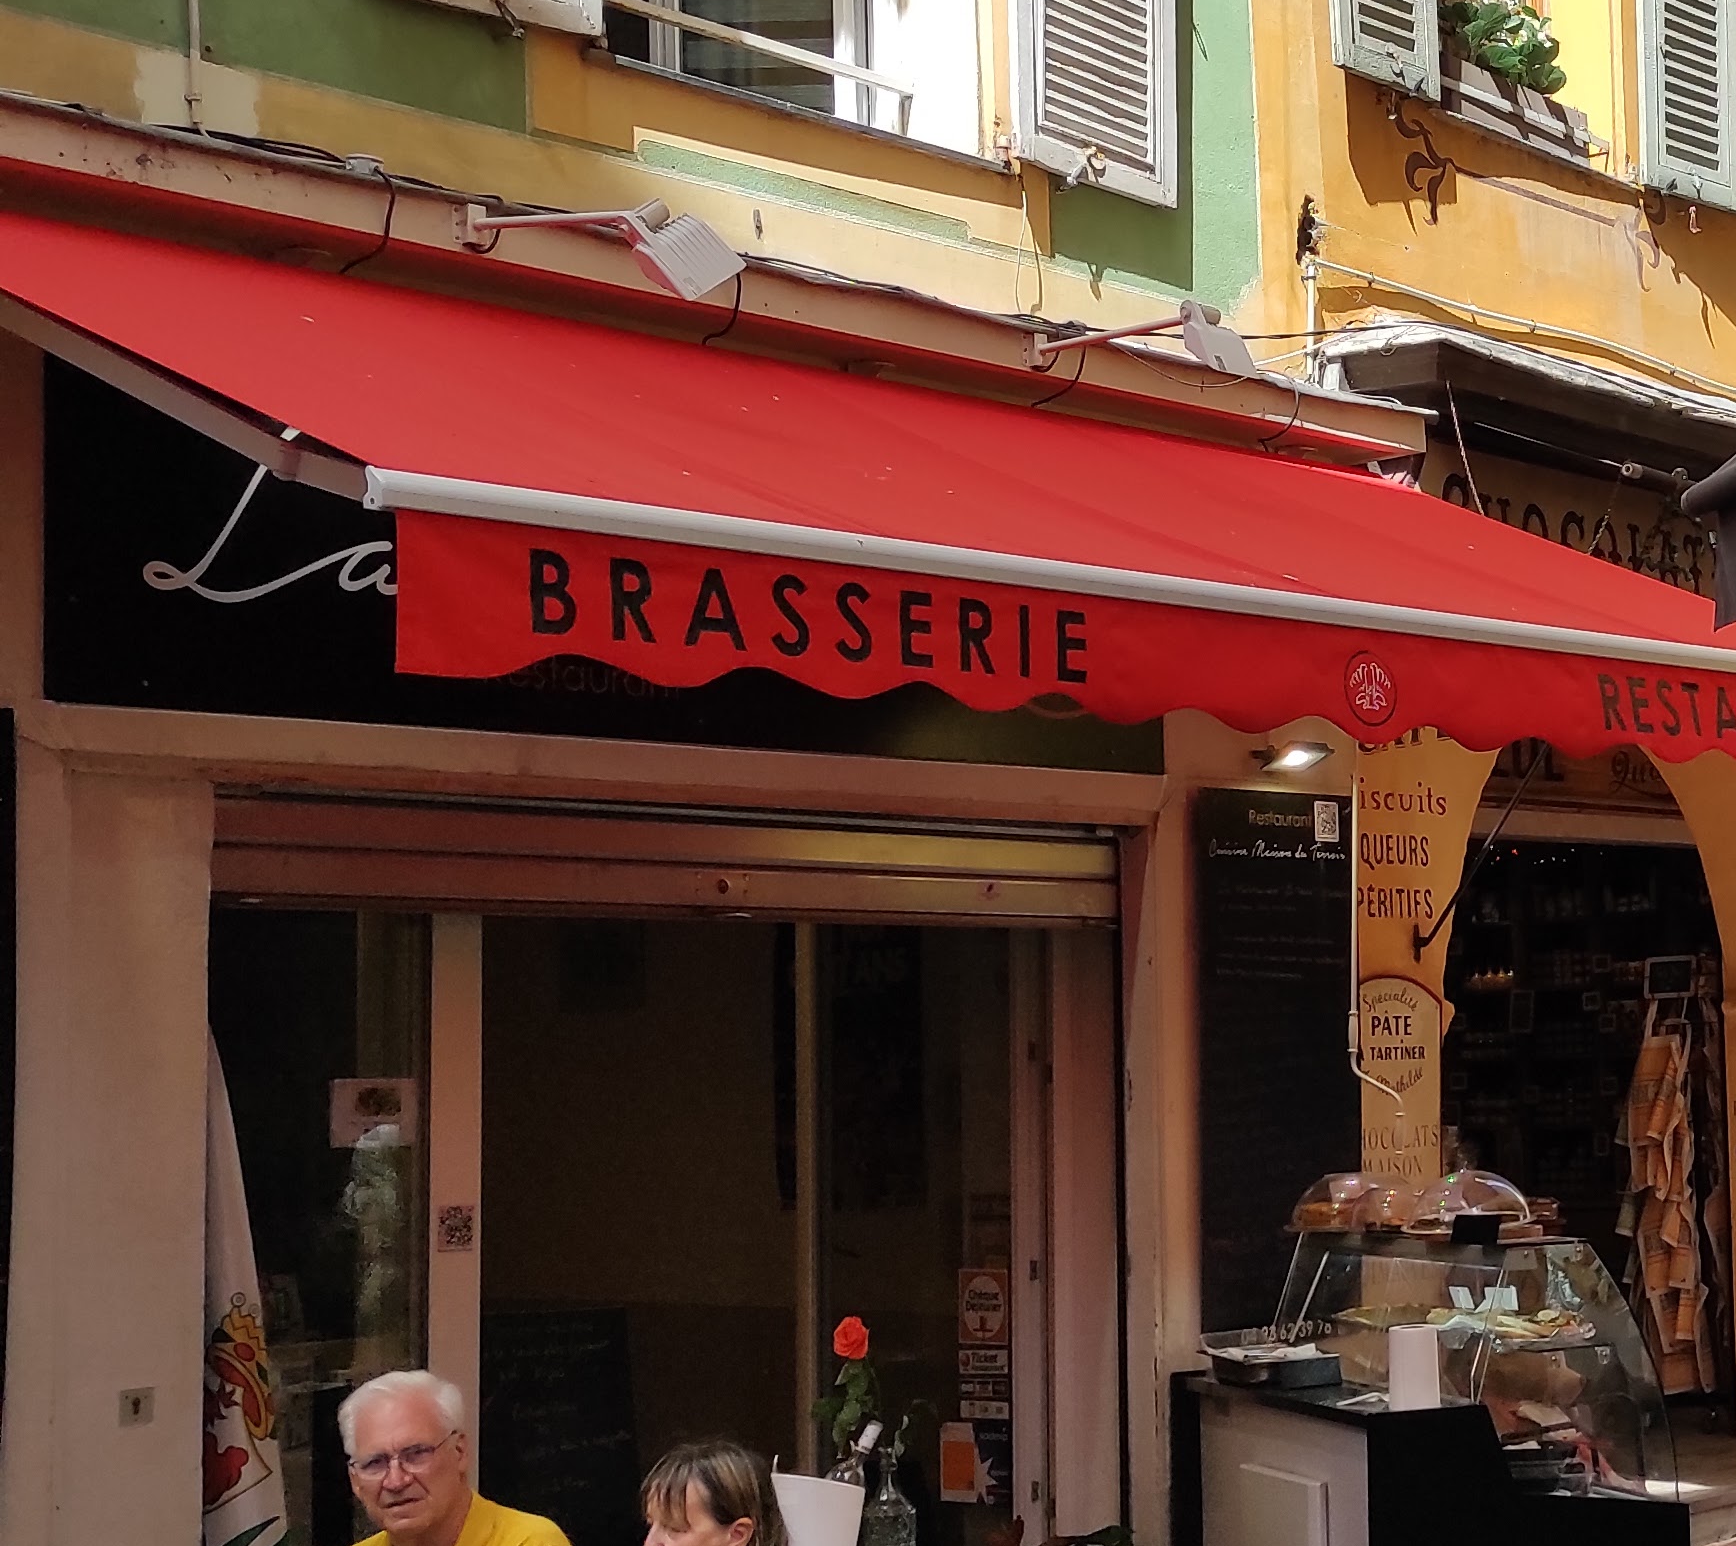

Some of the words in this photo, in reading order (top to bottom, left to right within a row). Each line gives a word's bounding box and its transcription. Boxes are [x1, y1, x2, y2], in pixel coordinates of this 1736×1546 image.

[528, 546, 1090, 686] BRASSERIE
[1358, 775, 1448, 818] iscuits
[1359, 832, 1430, 871] QUEURS
[1357, 883, 1434, 920] PÉRITIFS
[1369, 1039, 1426, 1061] TARTINER
